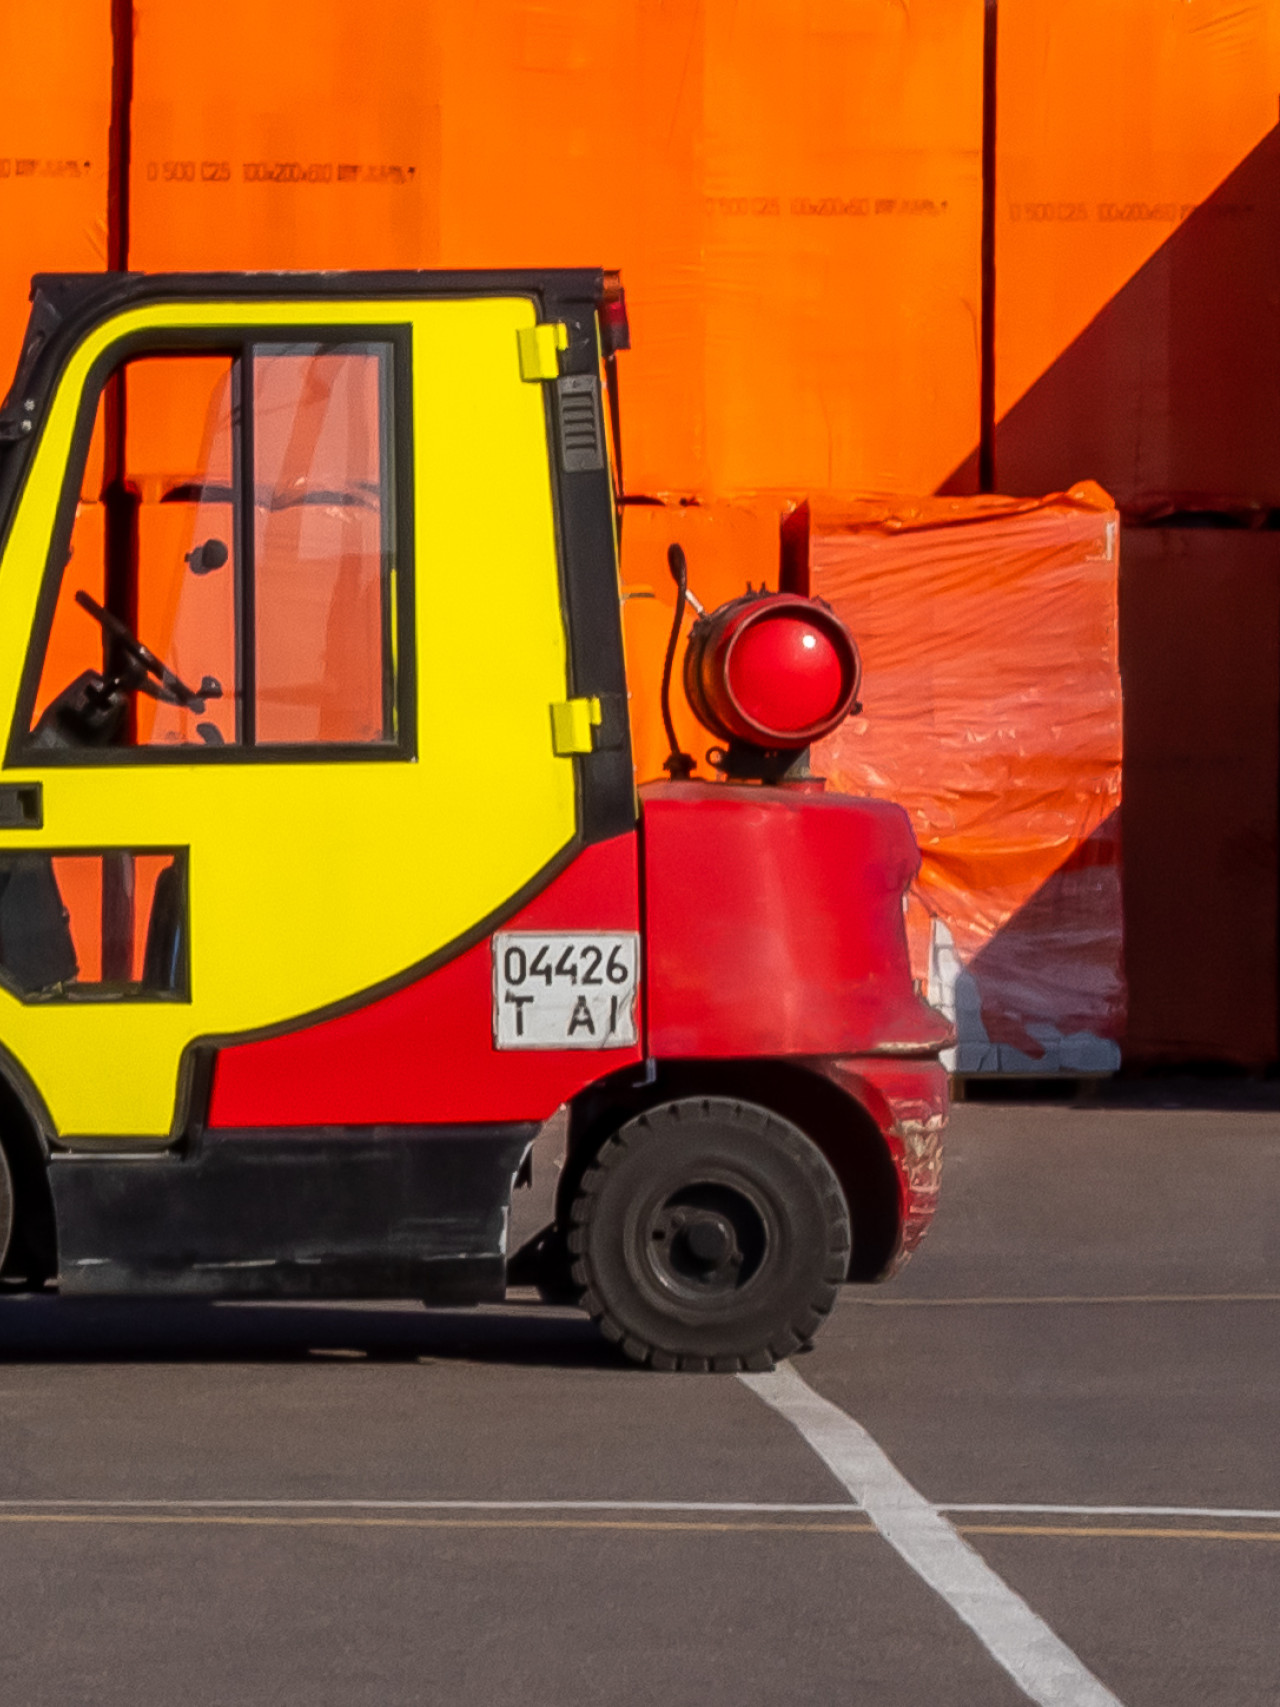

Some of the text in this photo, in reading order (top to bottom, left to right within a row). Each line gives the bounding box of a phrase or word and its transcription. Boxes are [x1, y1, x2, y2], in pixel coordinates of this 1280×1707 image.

[162, 161, 196, 183] 500
[504, 944, 629, 986] 04426
[505, 990, 534, 1036] T
